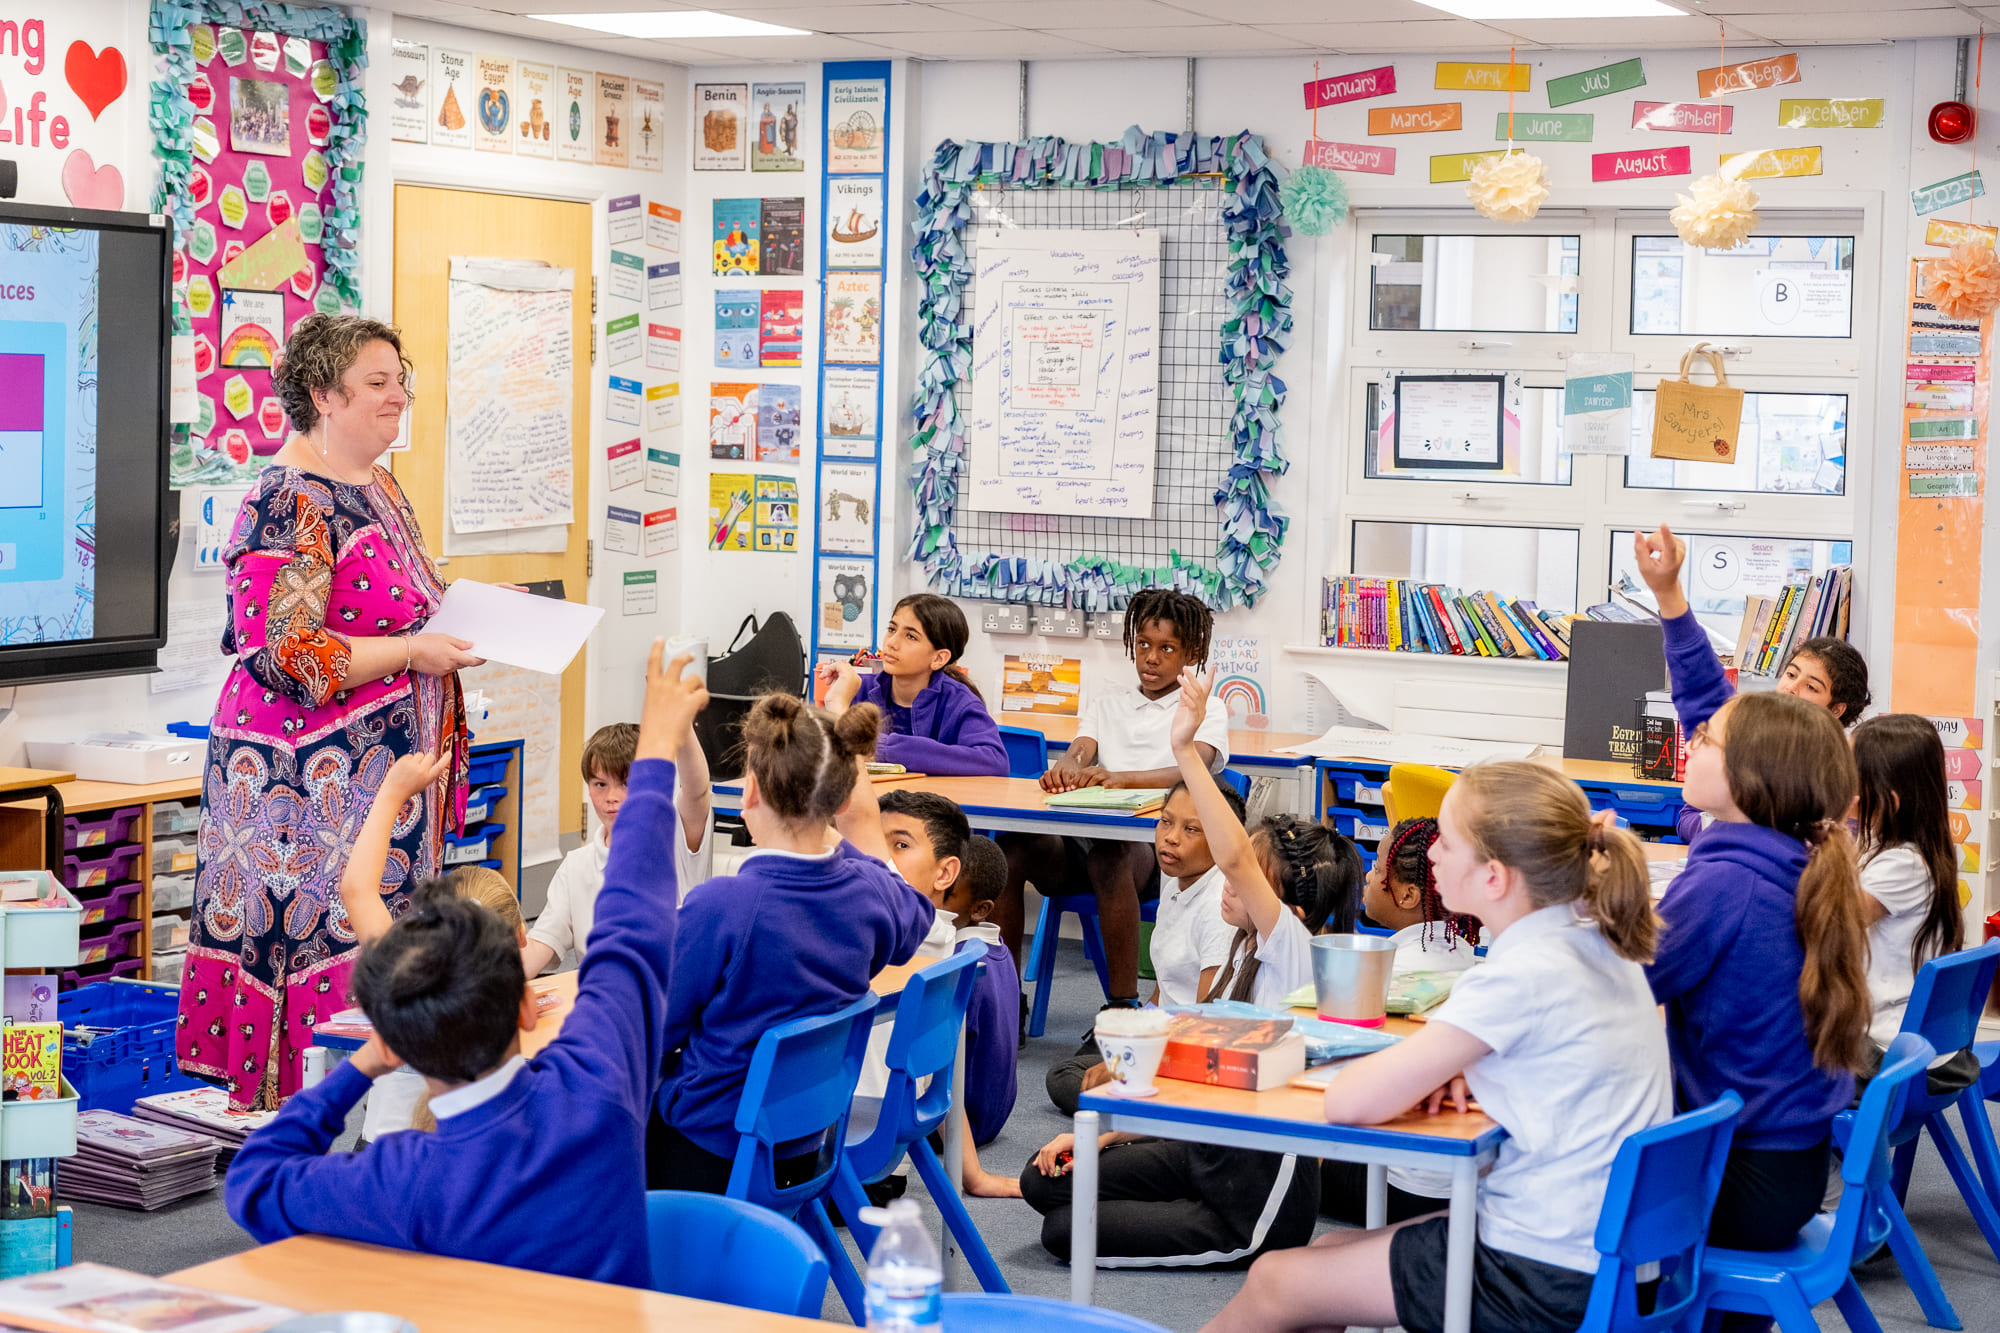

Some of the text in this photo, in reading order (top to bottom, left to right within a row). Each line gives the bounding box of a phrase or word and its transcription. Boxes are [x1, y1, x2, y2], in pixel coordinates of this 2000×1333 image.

[441, 53, 464, 66] Stone
[445, 66, 460, 80] Age
[480, 60, 509, 73] Ancient
[484, 71, 505, 84] Egypt
[568, 73, 583, 86] Iron
[1464, 68, 1500, 85] April
[1580, 71, 1611, 94] July
[1714, 64, 1782, 90] October
[601, 79, 625, 92] Ancient
[835, 85, 879, 95] Early Islamic
[1321, 75, 1377, 100] January
[568, 86, 582, 99] Age
[705, 90, 737, 102] Benin
[757, 88, 802, 97] Anglo-Saxons
[834, 95, 879, 104] Civilization
[1390, 111, 1440, 129] March
[1792, 105, 1870, 123] December
[1526, 119, 1563, 136] June
[1317, 146, 1381, 167] February
[1615, 153, 1668, 174] August
[837, 184, 873, 196] Vikings
[1922, 181, 1974, 211] 2025
[837, 281, 870, 292] Aztec
[1776, 282, 1789, 302] B
[1593, 384, 1608, 393] MRS
[1682, 401, 1710, 420] Mrs
[1926, 482, 1959, 491] Geography
[1713, 551, 1727, 569] S
[1215, 639, 1258, 648] YOU CAN
[1021, 652, 1063, 663] ANCIENT
[1213, 649, 1258, 660] DO HARD
[1027, 663, 1053, 672] EGYPT
[1215, 661, 1260, 673] THINGS
[13, 1029, 28, 1037] THE
